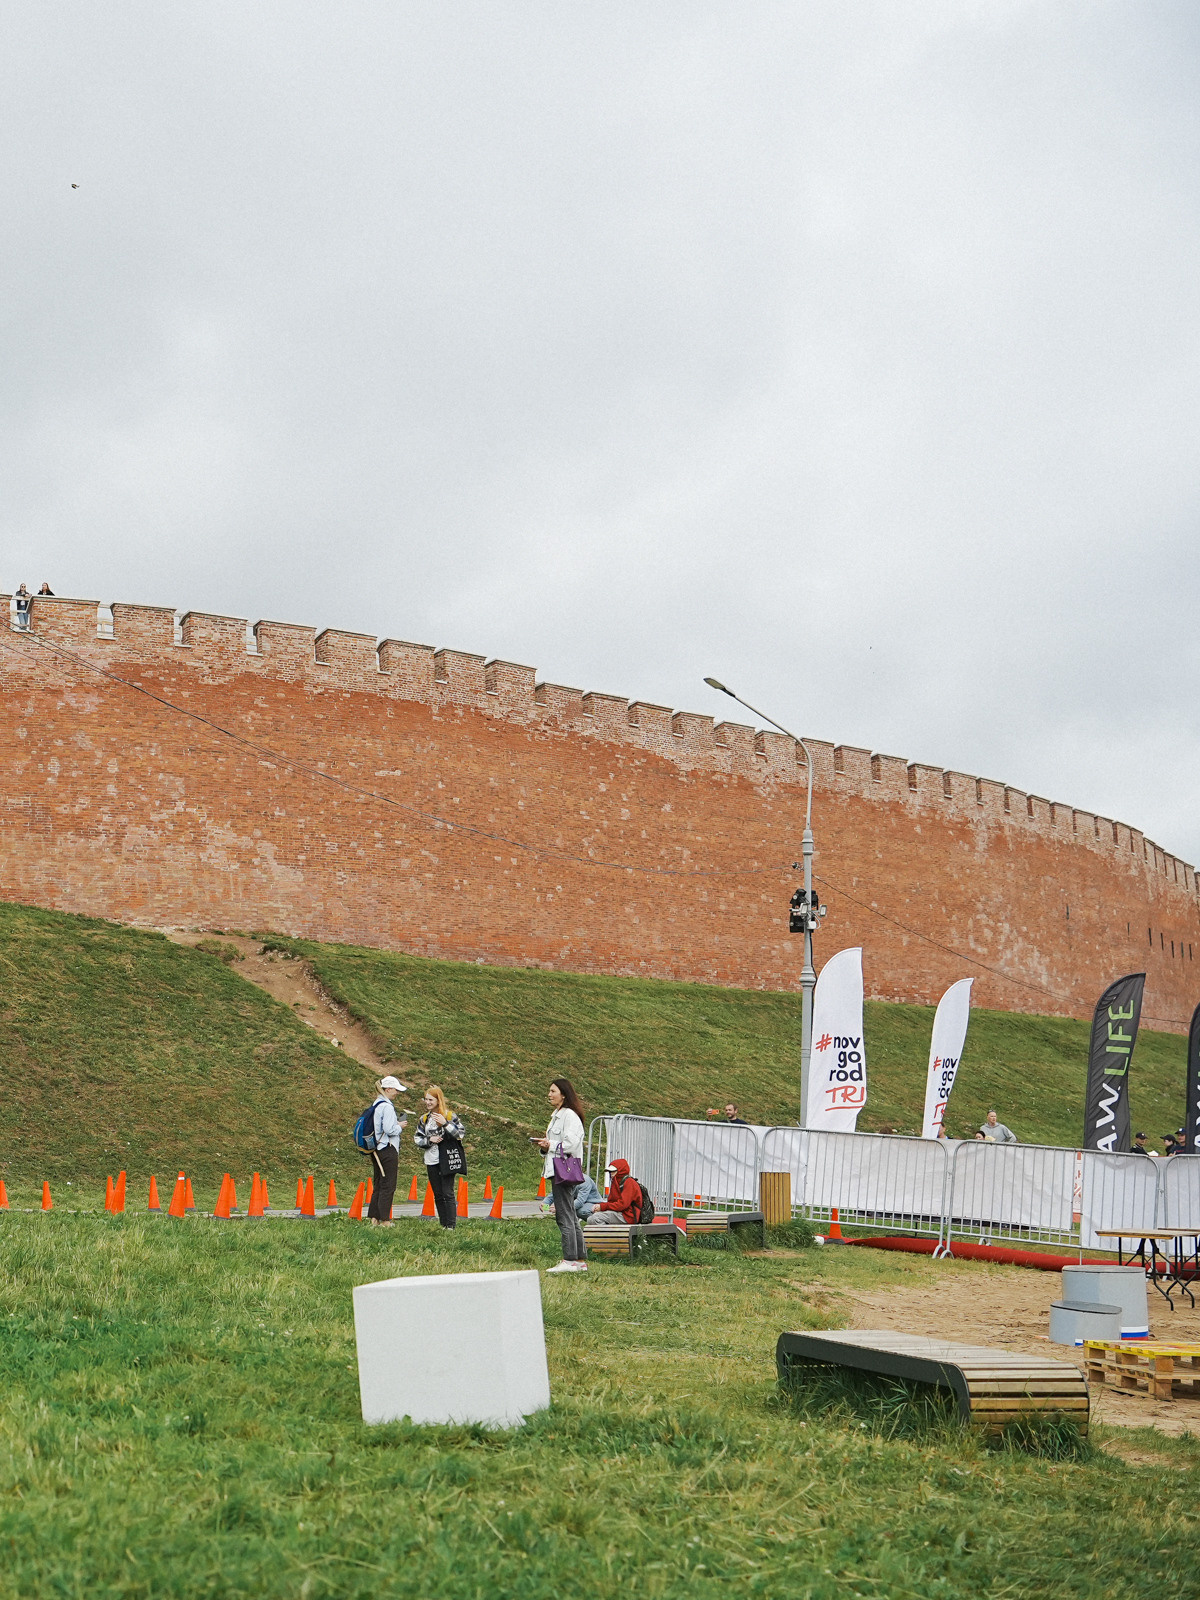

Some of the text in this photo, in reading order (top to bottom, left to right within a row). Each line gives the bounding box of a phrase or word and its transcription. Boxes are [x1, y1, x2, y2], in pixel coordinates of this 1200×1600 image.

[815, 1033, 861, 1052] #nov
[1104, 999, 1134, 1076] LIFE
[837, 1051, 862, 1069] go
[829, 1062, 864, 1082] rod
[825, 1085, 865, 1104] TRI
